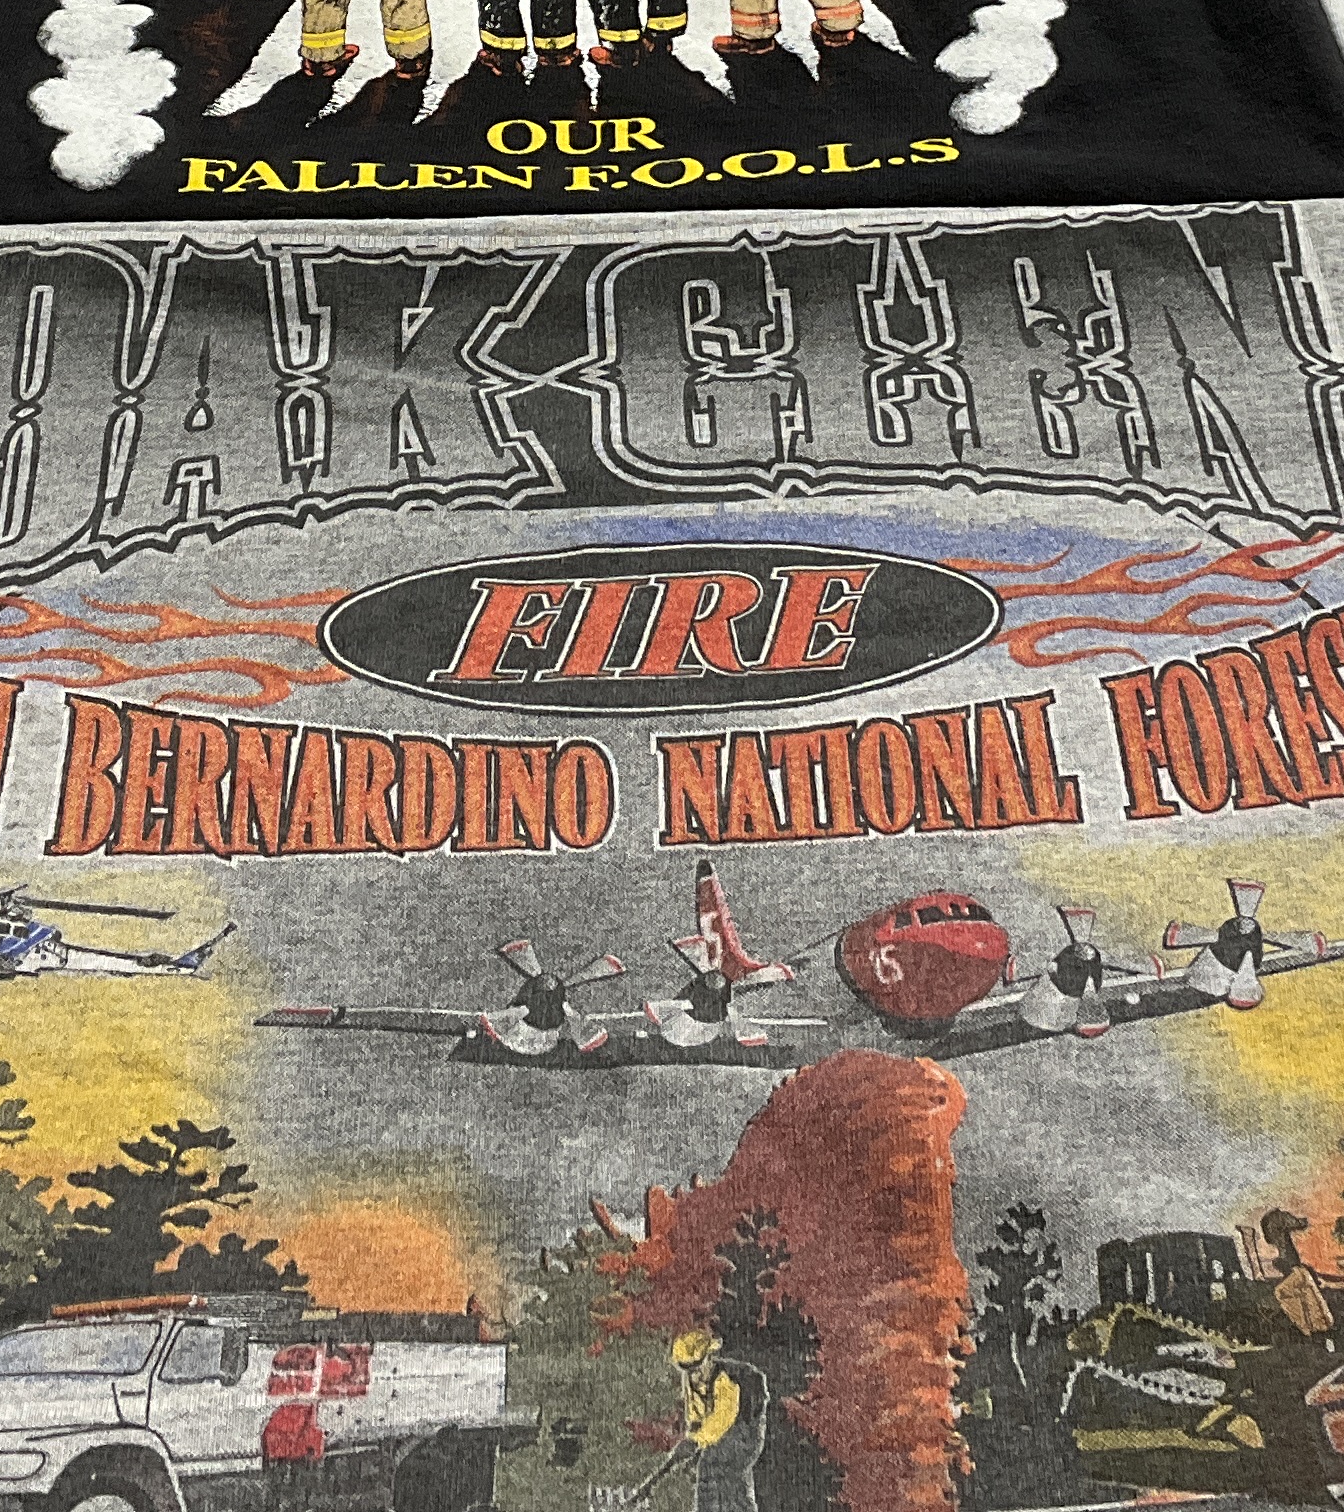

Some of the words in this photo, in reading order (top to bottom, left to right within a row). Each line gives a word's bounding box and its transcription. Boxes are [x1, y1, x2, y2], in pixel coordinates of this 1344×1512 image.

[177, 157, 543, 196] FALLEN
[562, 136, 962, 194] F.O.O.L.S
[484, 116, 665, 156] OUR
[431, 564, 884, 688] FIRE
[45, 687, 617, 862] BERNARDINO
[656, 690, 1081, 855] NATIONAL
